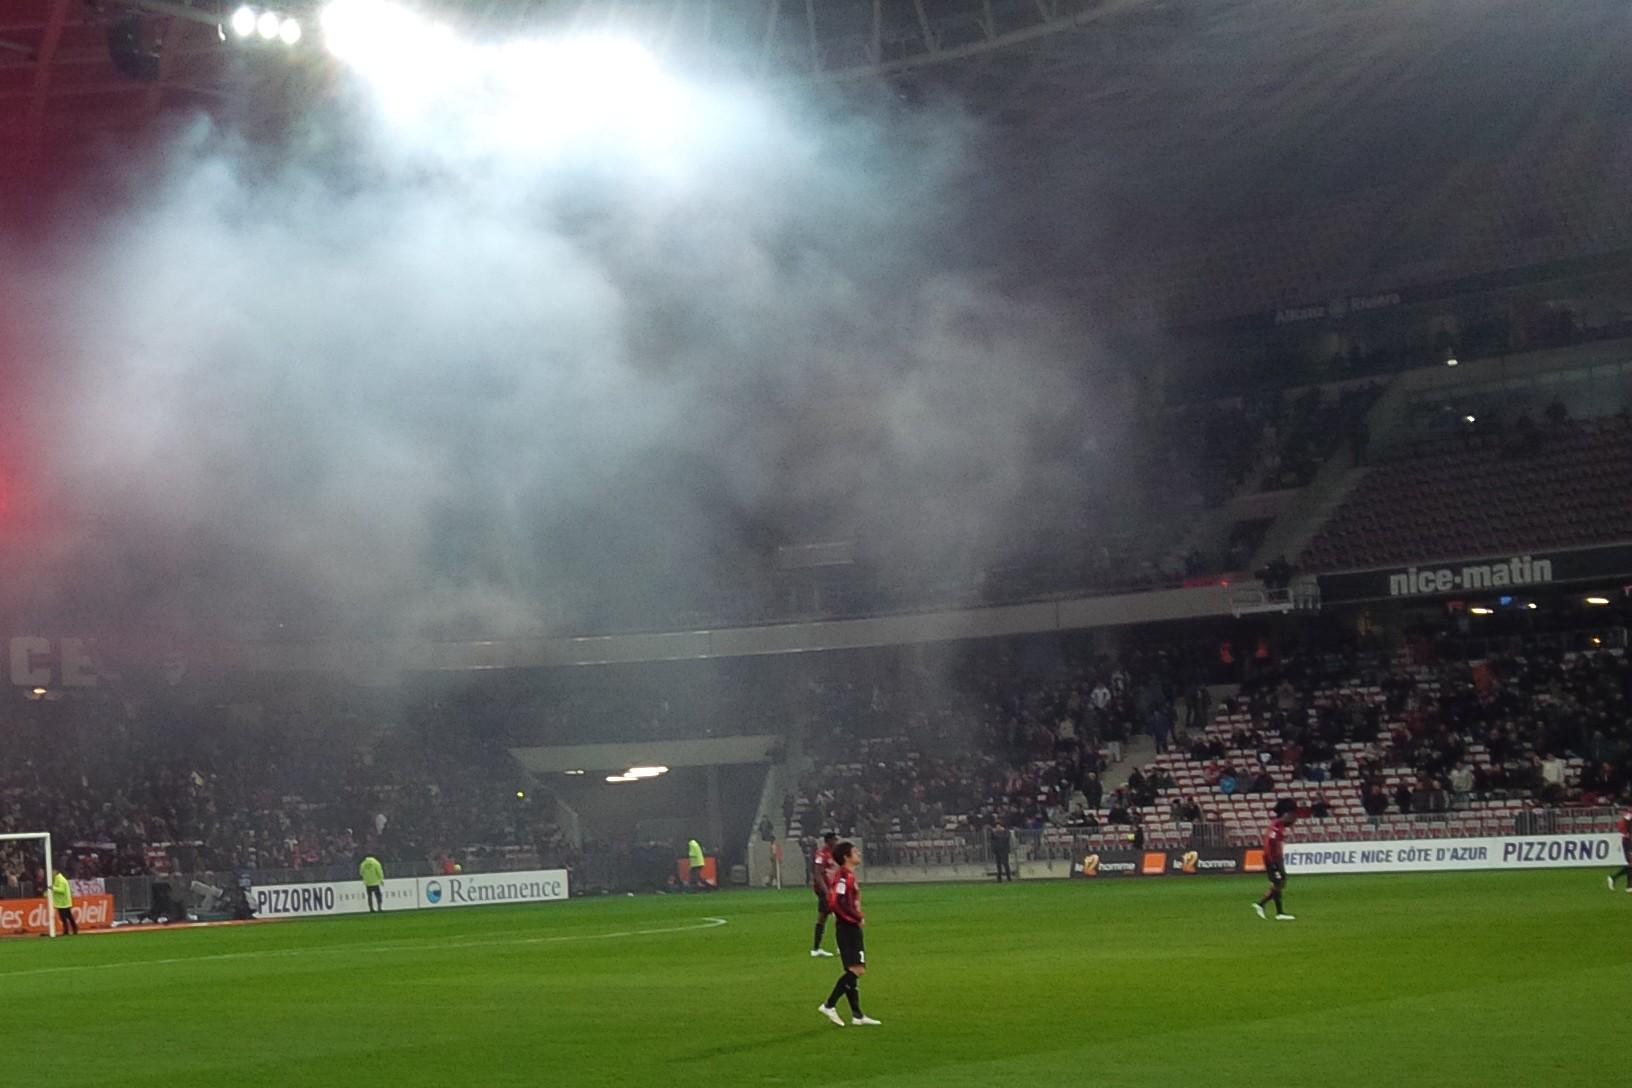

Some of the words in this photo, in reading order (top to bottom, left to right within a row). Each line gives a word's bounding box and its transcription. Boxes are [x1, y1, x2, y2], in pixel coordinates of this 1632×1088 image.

[1360, 850, 1393, 864] NICE
[1397, 846, 1433, 863] CÔTE
[1436, 846, 1487, 862] D'AZUR
[1503, 840, 1610, 863] PIZZORNO
[257, 887, 335, 914] PIZZORNO
[448, 877, 562, 904] Rémanence
[73, 900, 108, 924] oleil
